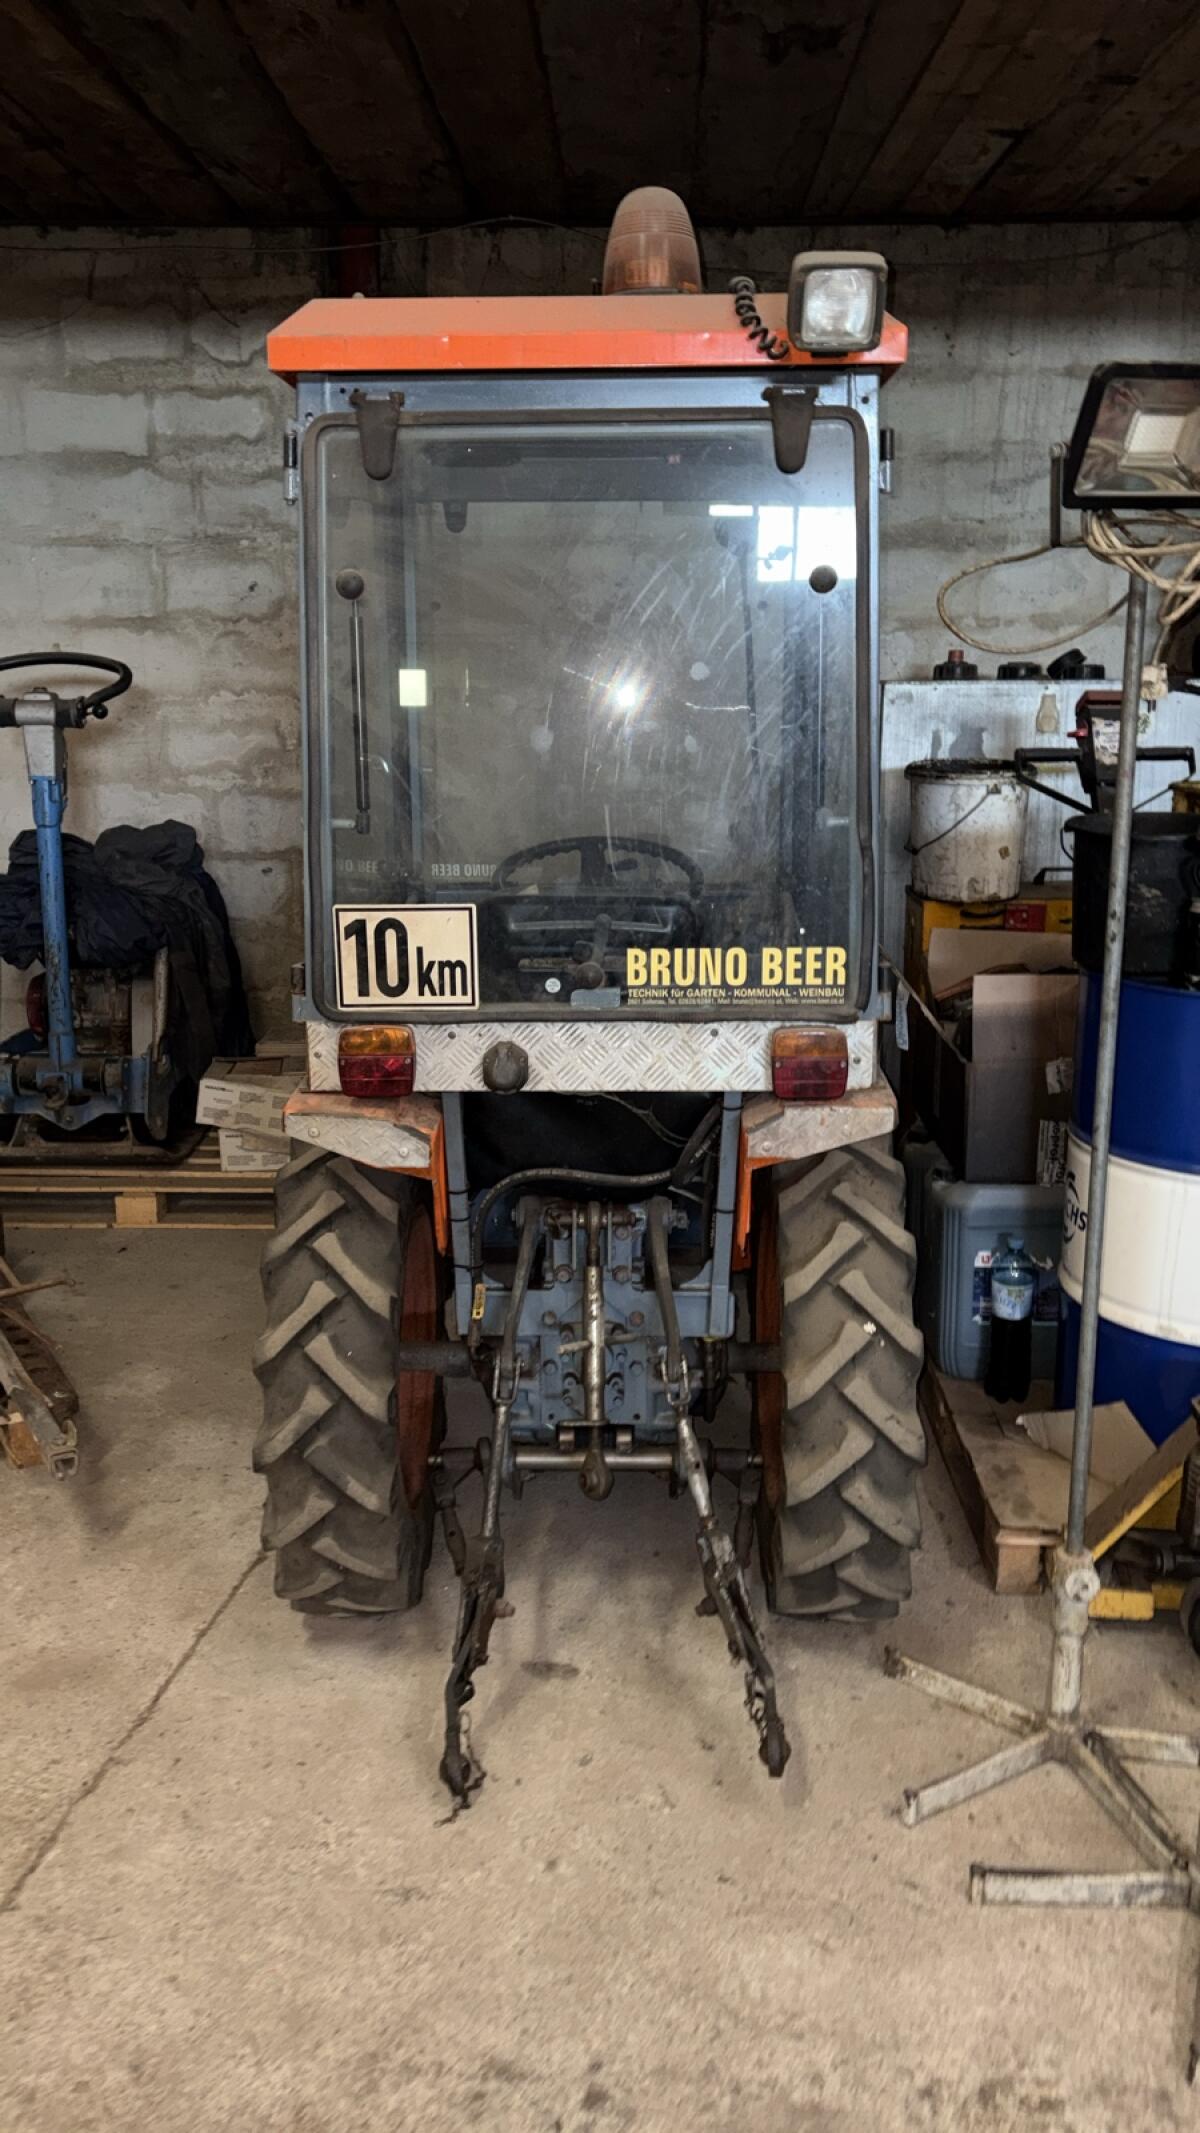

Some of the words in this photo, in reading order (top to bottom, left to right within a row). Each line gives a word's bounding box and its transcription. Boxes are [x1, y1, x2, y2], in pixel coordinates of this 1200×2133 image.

[344, 917, 410, 998] 10
[416, 946, 468, 997] km
[627, 947, 747, 986] BRUNO
[762, 947, 846, 985] BEER
[628, 988, 669, 998] TECHNIK
[671, 988, 685, 998] für
[686, 988, 726, 998] GARTEN
[734, 988, 791, 998] KOMMUNAL
[799, 987, 845, 998] WEINBAU
